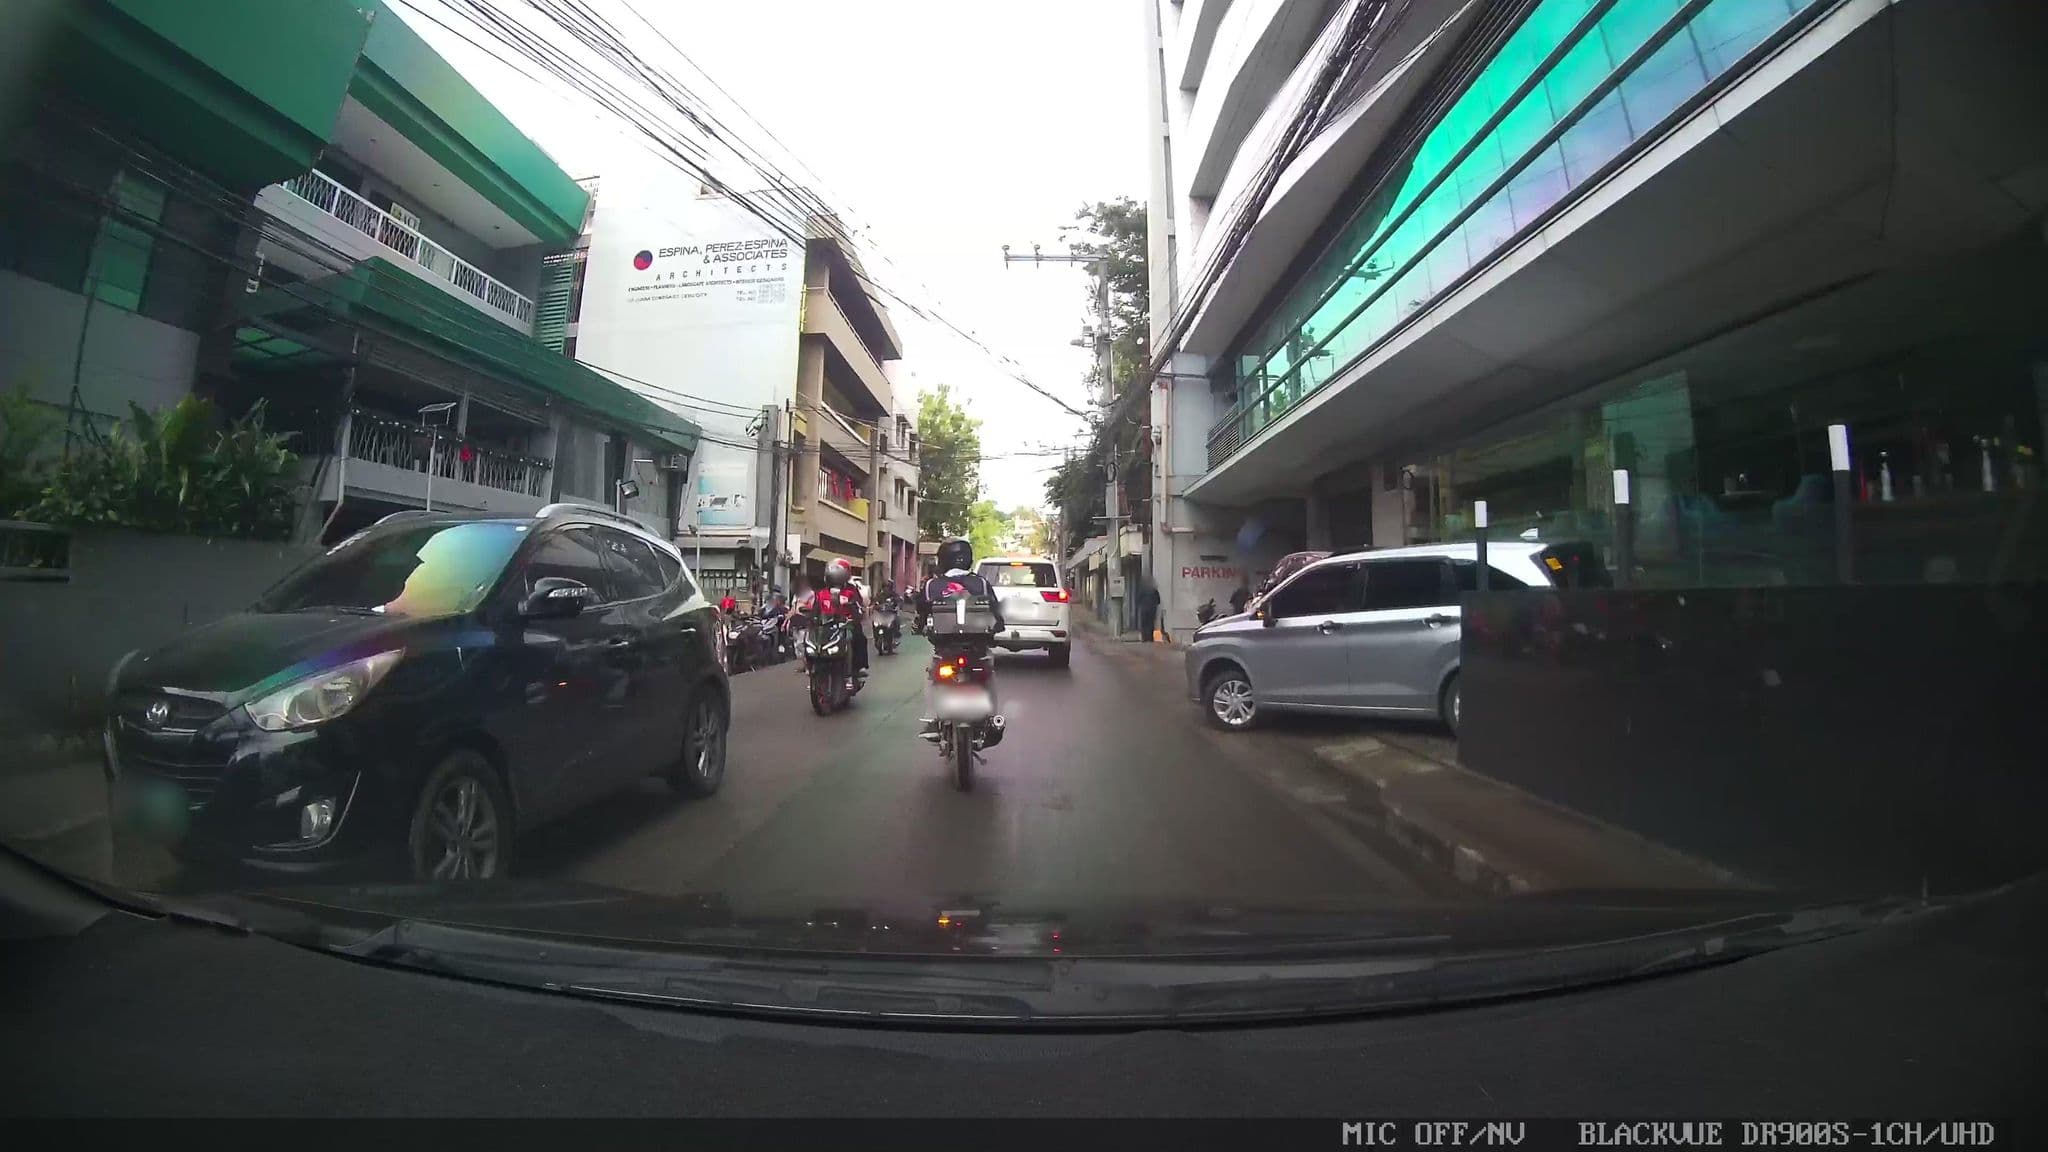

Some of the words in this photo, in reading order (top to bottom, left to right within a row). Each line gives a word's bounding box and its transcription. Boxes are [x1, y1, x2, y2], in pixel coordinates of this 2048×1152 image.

[659, 246, 702, 258] ESPINA,
[706, 239, 788, 253] PEREZ-ESPINA
[703, 255, 710, 264] &
[713, 249, 788, 263] ASSOCIATES
